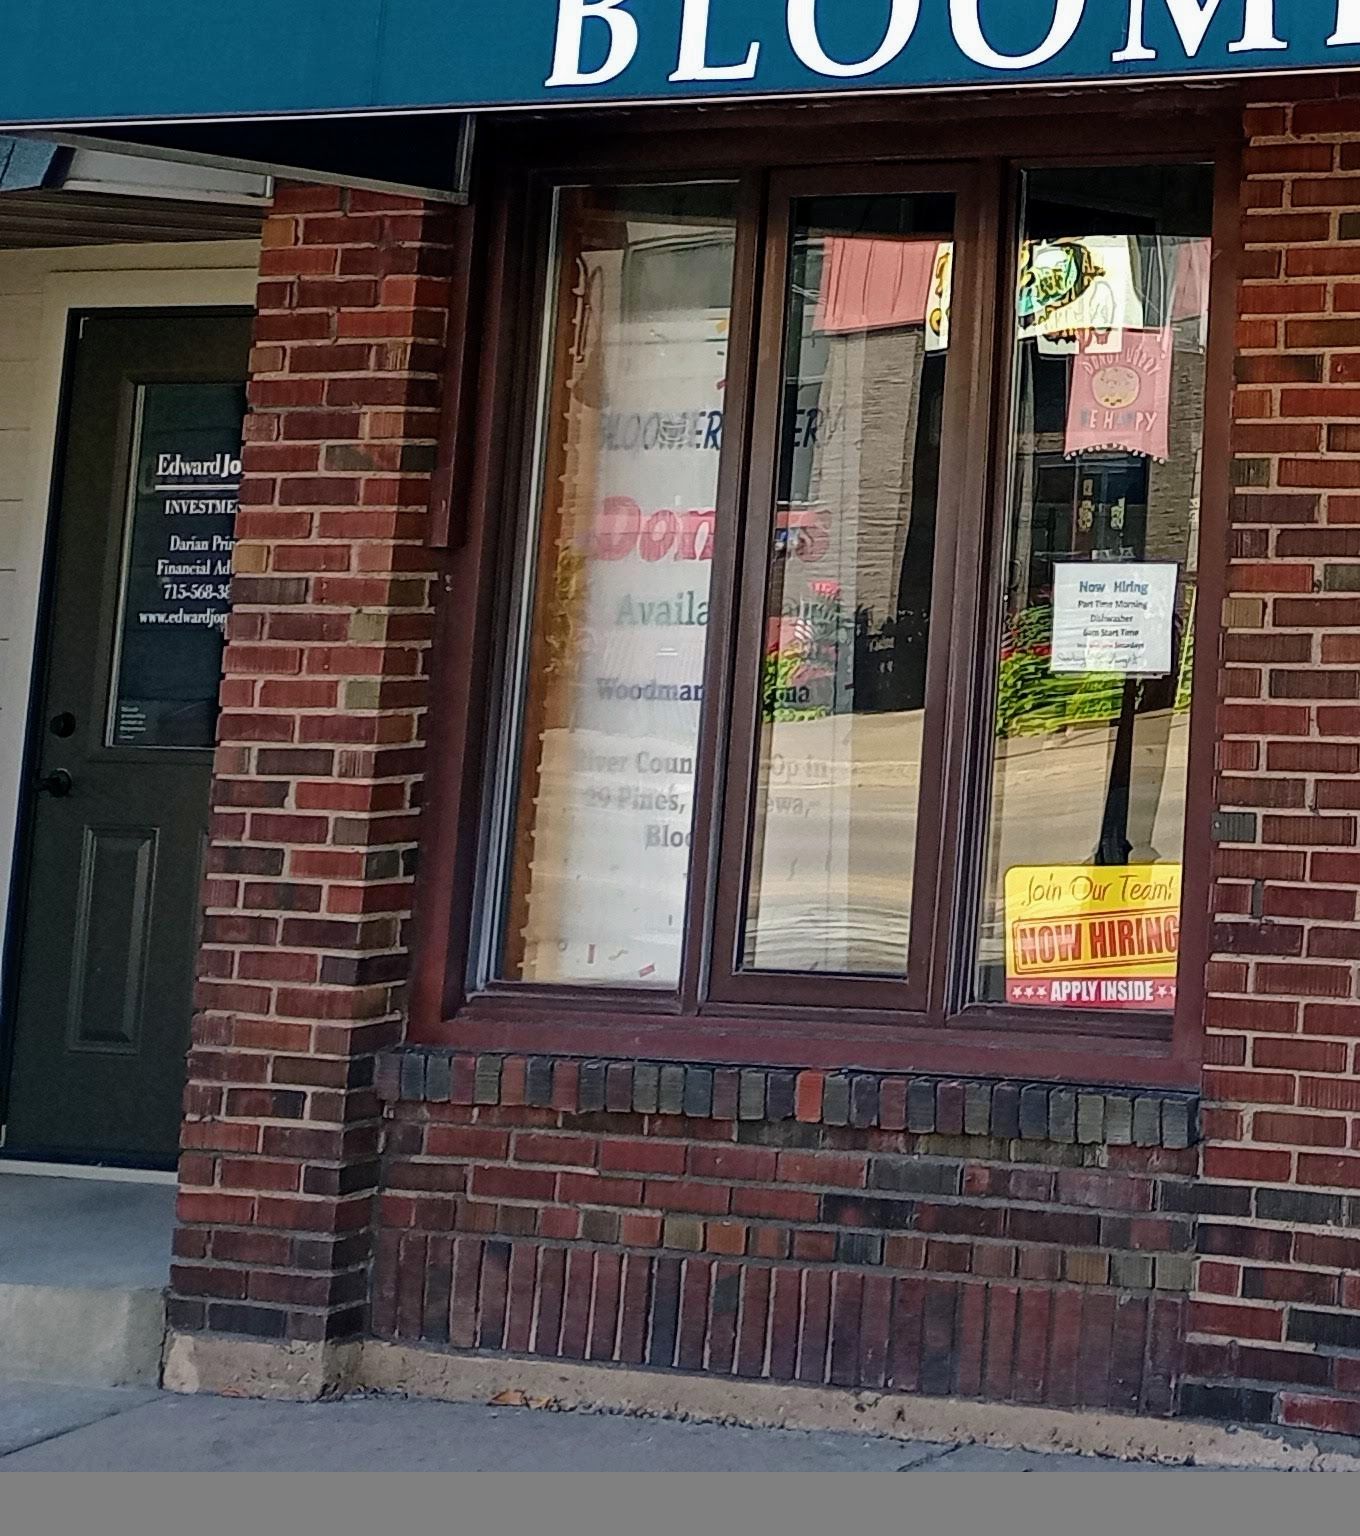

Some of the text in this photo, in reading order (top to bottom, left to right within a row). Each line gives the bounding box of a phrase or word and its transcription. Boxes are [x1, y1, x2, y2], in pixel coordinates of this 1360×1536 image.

[164, 499, 238, 514] INVESTME
[169, 535, 209, 551] Darian
[157, 559, 231, 575] Financial Ad
[164, 583, 231, 600] 715-568-38
[1079, 580, 1149, 595] Now Hiring
[616, 591, 709, 625] Availa
[1115, 600, 1148, 610] Morning
[139, 607, 228, 628] www.edwardjon
[635, 750, 692, 774] Coun
[1021, 873, 1174, 906] Join Our Team!
[1019, 914, 1180, 965] NOW HIRING
[1050, 980, 1154, 1001] APPLY INSIDE
